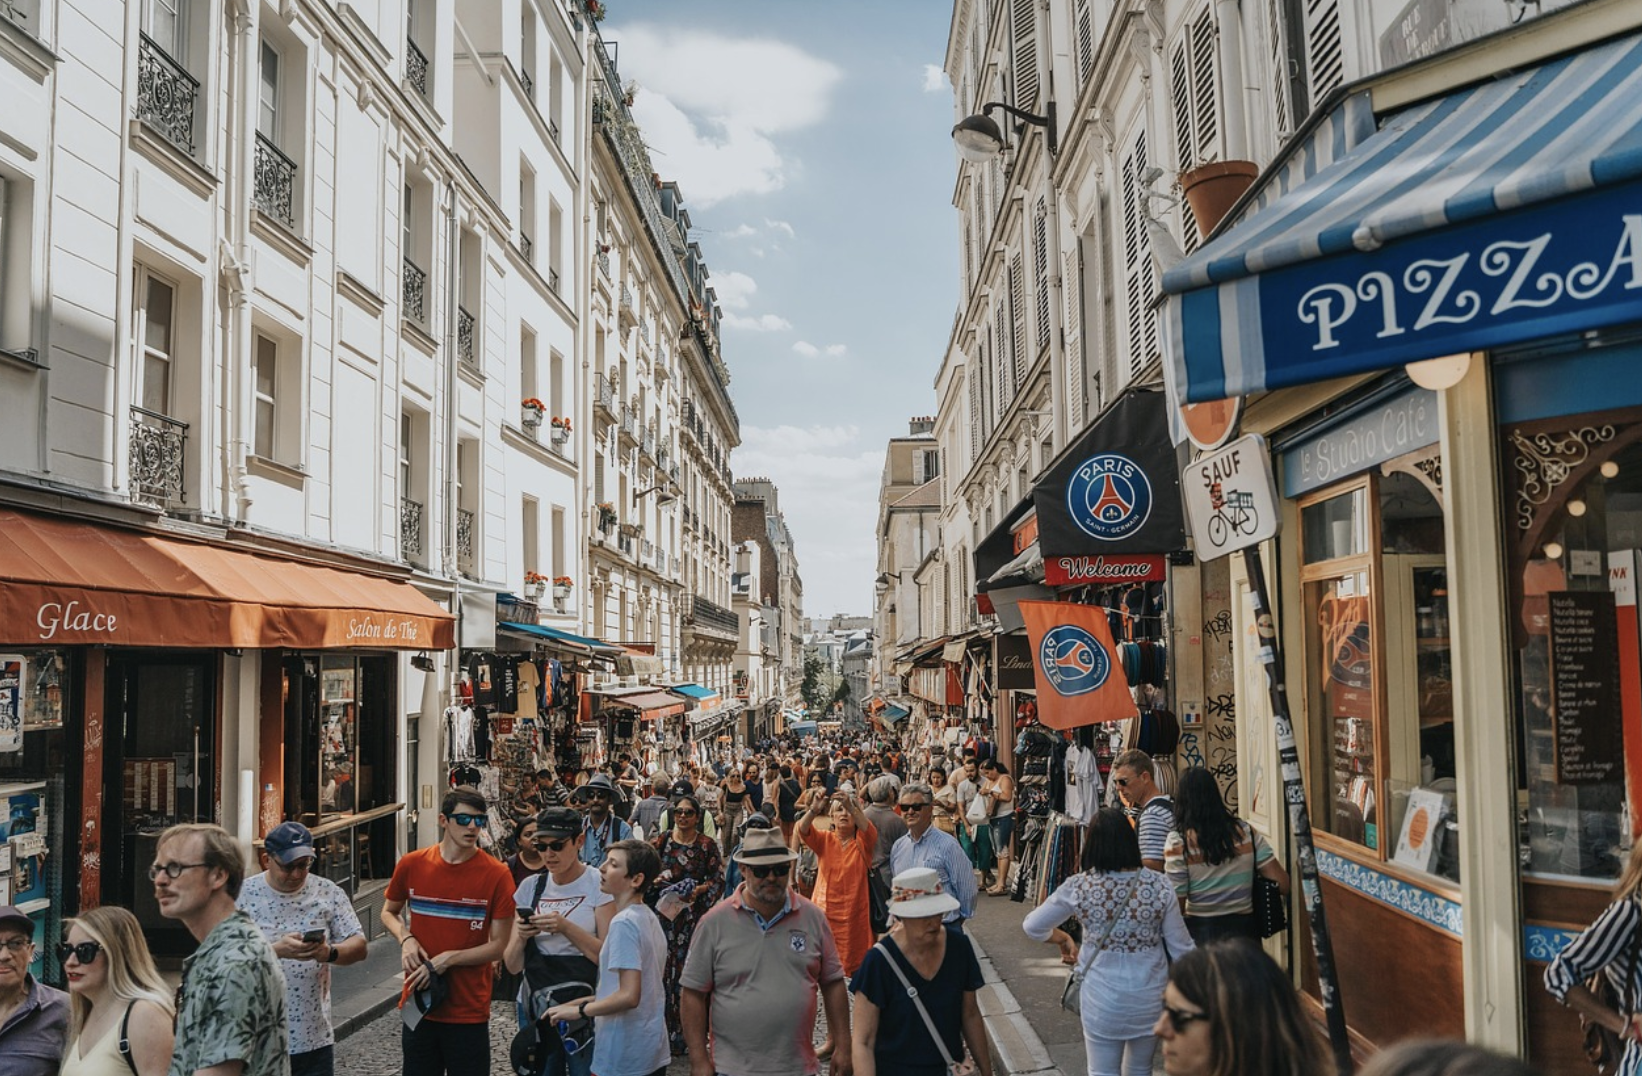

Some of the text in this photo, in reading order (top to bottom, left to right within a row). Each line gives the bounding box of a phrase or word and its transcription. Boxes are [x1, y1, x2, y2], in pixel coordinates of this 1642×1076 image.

[1297, 213, 1642, 351] PIZZA
[1316, 427, 1377, 482] Studio
[1381, 398, 1427, 455] Café
[1080, 459, 1135, 482] PARIS
[1201, 449, 1241, 488] SAUF
[1058, 555, 1152, 580] Welcome
[36, 600, 118, 639] Glace
[346, 616, 418, 640] Salon de Thé
[470, 921, 483, 931] 94
